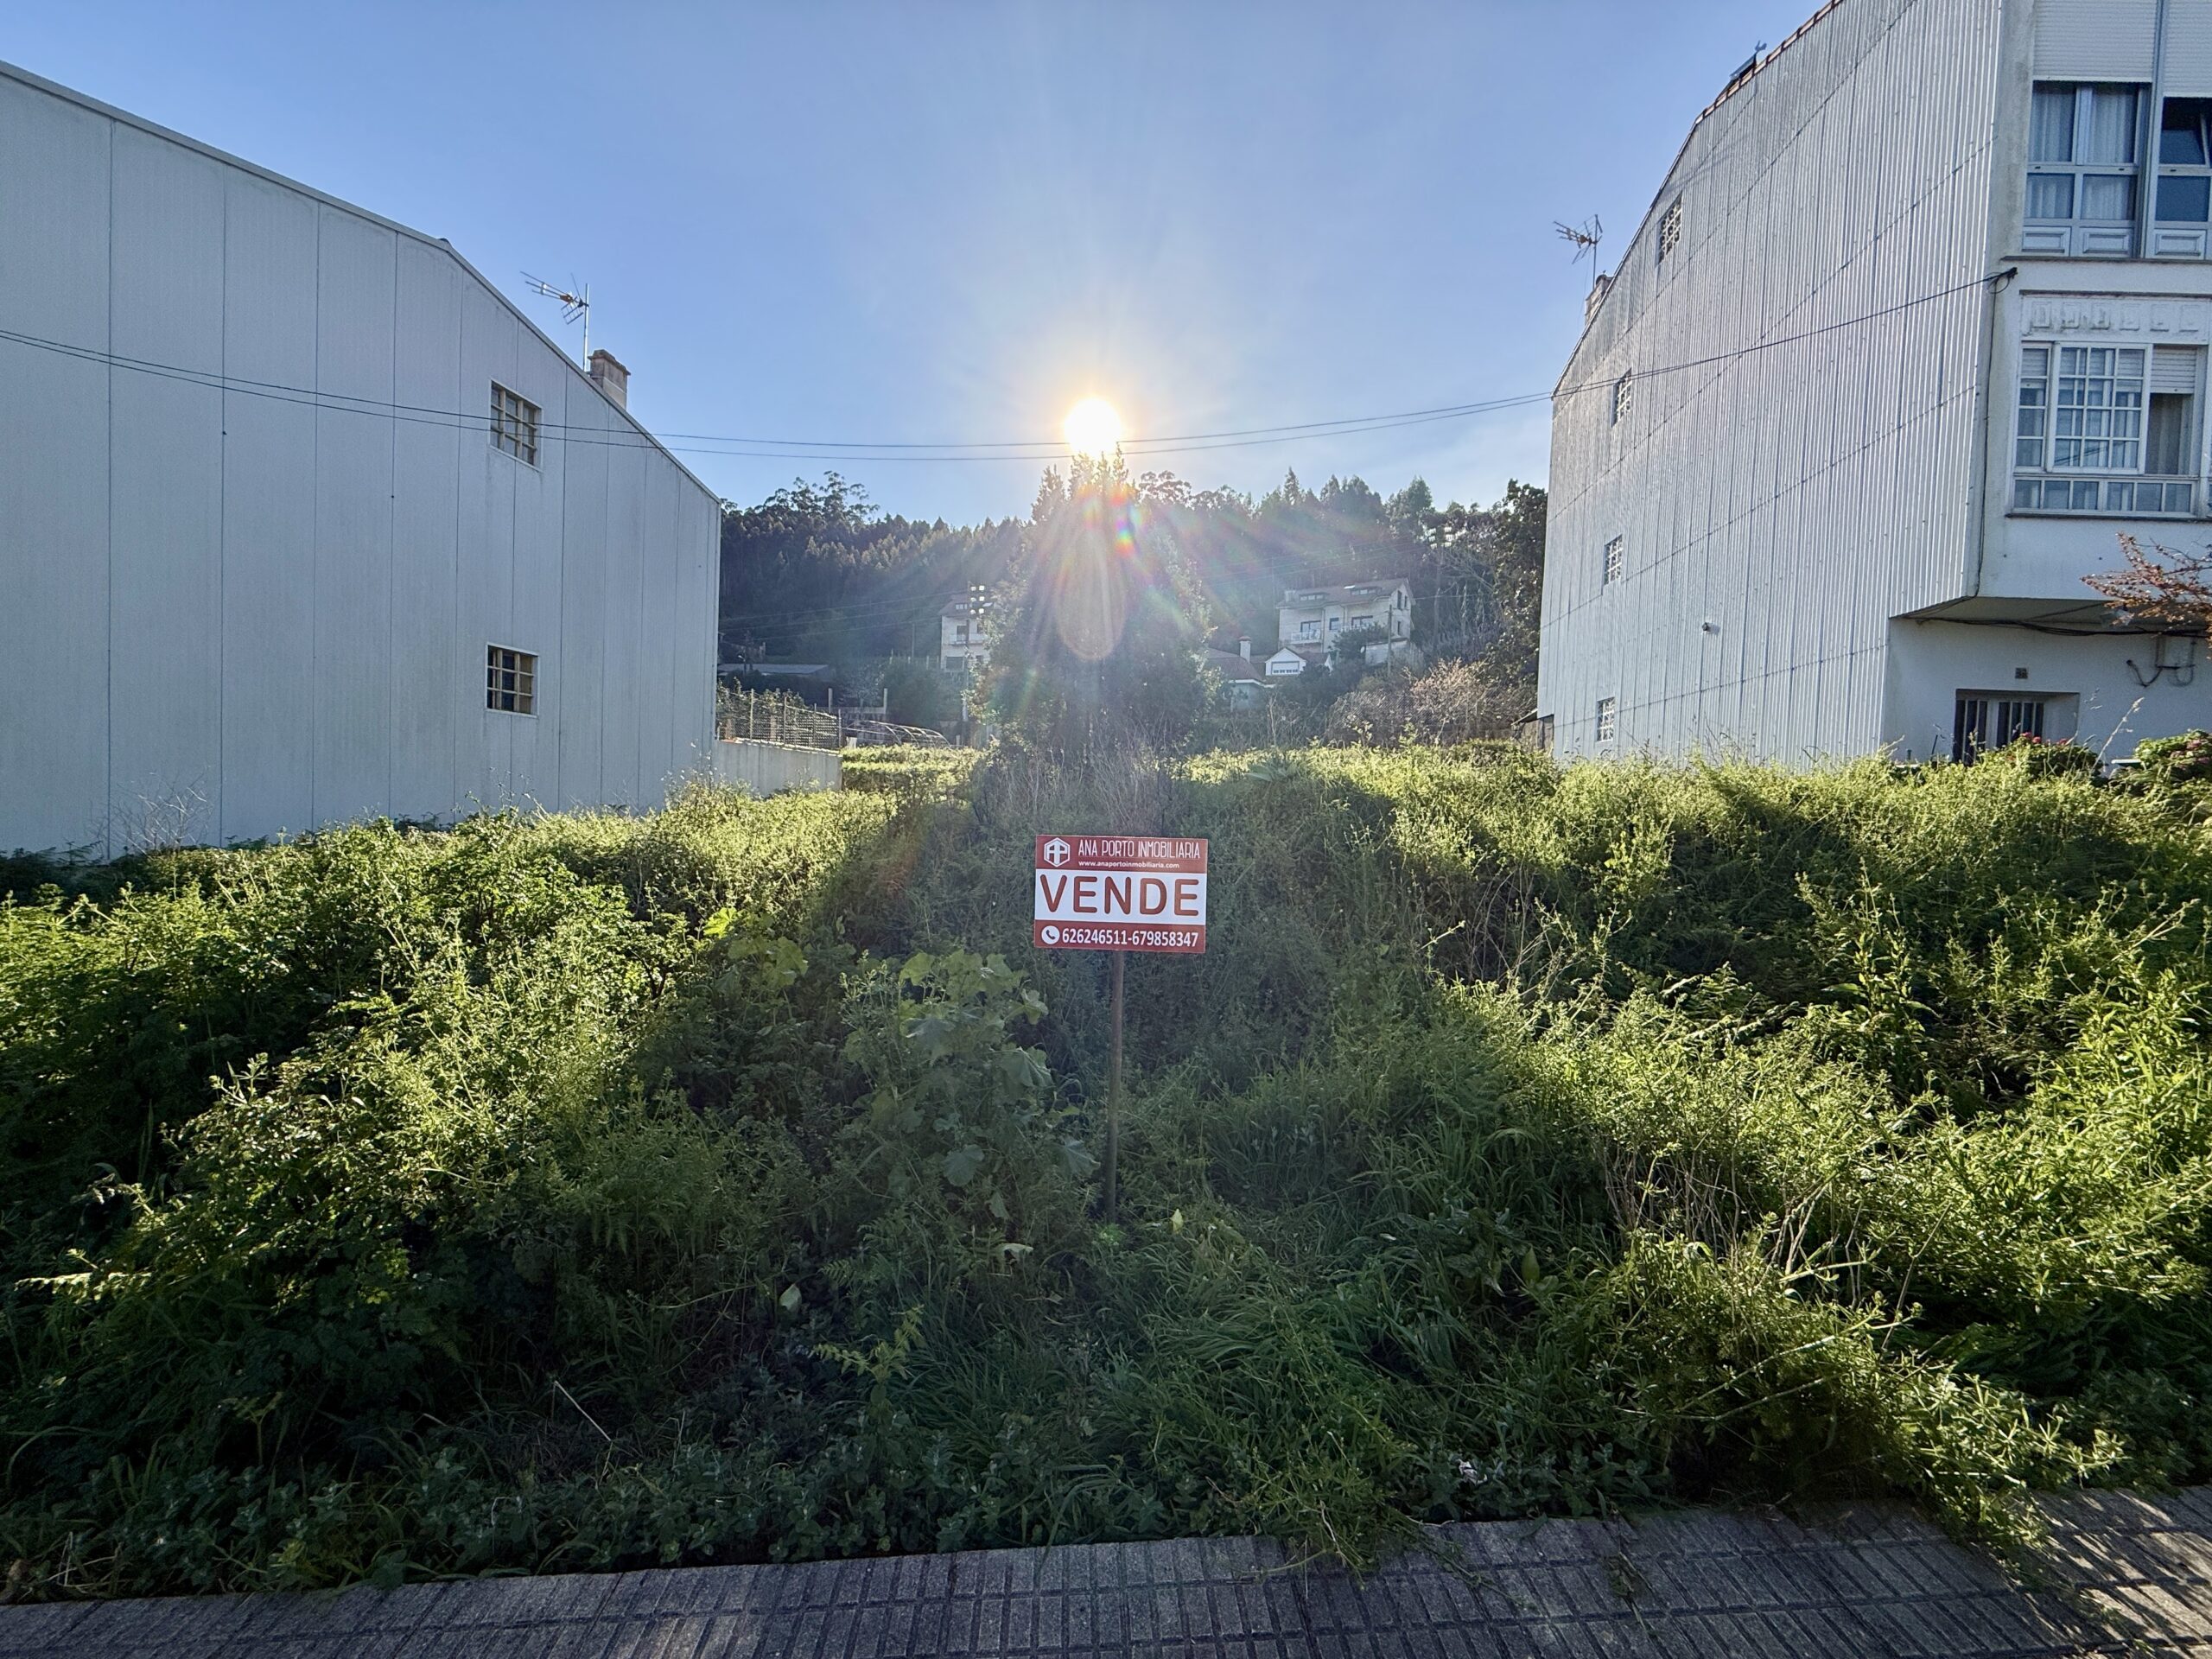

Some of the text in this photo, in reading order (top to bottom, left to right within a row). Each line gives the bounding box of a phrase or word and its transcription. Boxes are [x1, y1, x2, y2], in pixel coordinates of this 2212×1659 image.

[1078, 839, 1200, 859] ANA PORTO INMOBILIARIA
[1040, 874, 1199, 916] VENDE
[1062, 928, 1198, 947] 626246511-679858347
